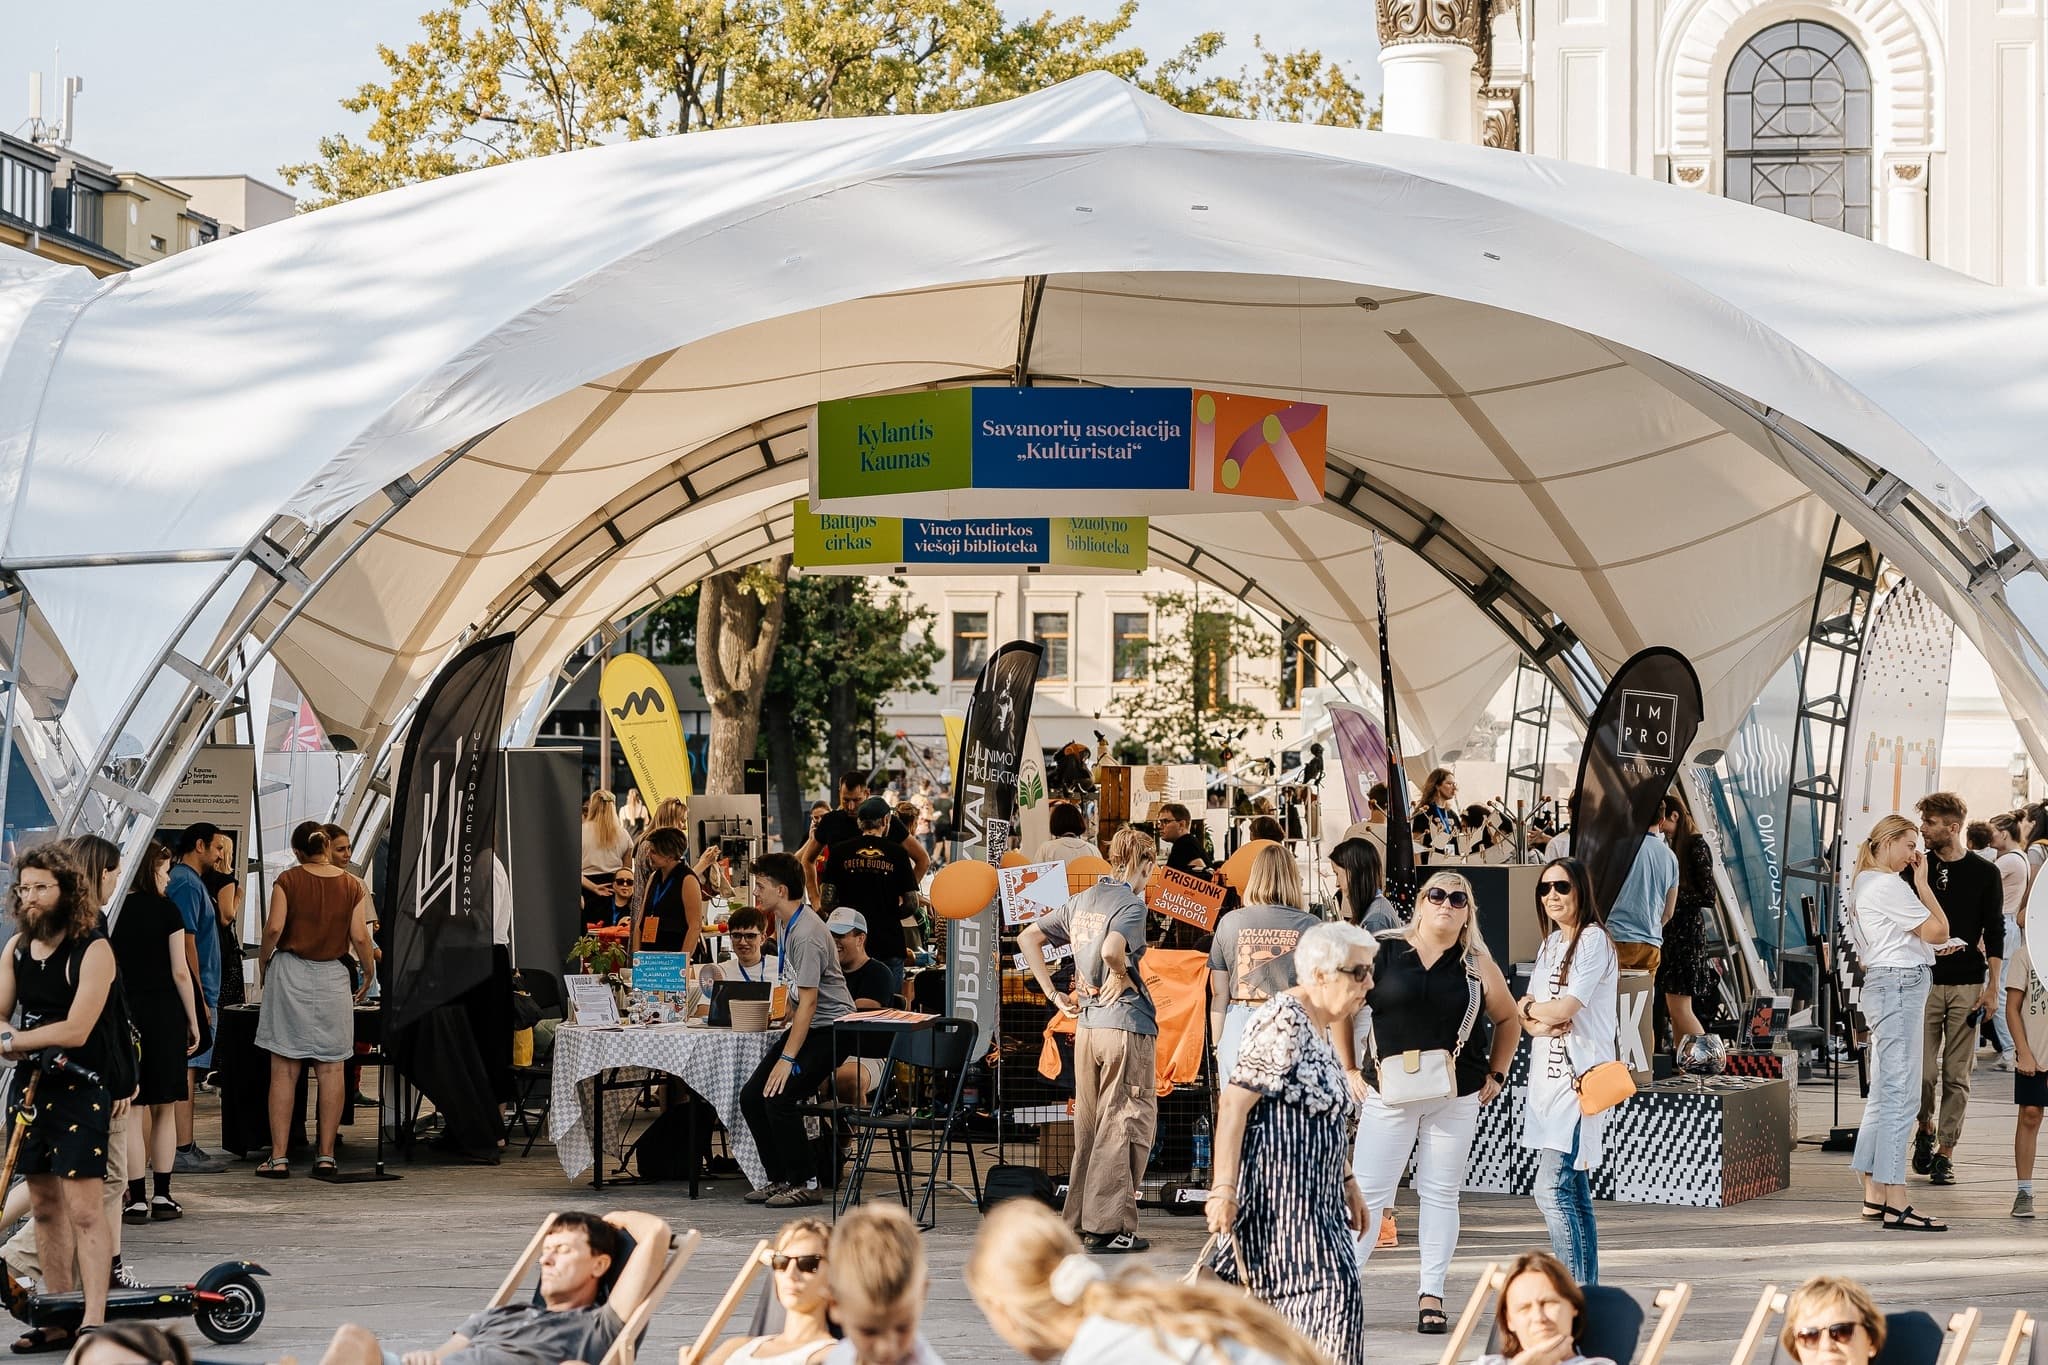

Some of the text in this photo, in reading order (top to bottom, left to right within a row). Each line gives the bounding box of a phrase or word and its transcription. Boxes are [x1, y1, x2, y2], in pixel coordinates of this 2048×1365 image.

[858, 418, 934, 451] Kylantis
[982, 419, 1181, 442] Savanorių asociacija
[860, 450, 931, 473] Kaunas
[1016, 442, 1142, 462] „Kultūristai“
[920, 522, 1033, 536] Vinco Kudirkos
[825, 533, 872, 551] cirkas
[914, 539, 1038, 556] viešoji biblioteka
[1066, 534, 1129, 554] biblioteka
[968, 745, 1014, 766] JAUNIMO
[1623, 762, 1666, 776] KAUNAS
[463, 732, 481, 917] ULNA DANCE COMPANY
[1164, 869, 1222, 899] PRISIJUNK
[1162, 887, 1208, 914] kultūros
[1154, 898, 1208, 927] savanorių
[1237, 937, 1297, 946] SAVANORIS
[1238, 928, 1300, 938] VOLUNTEER
